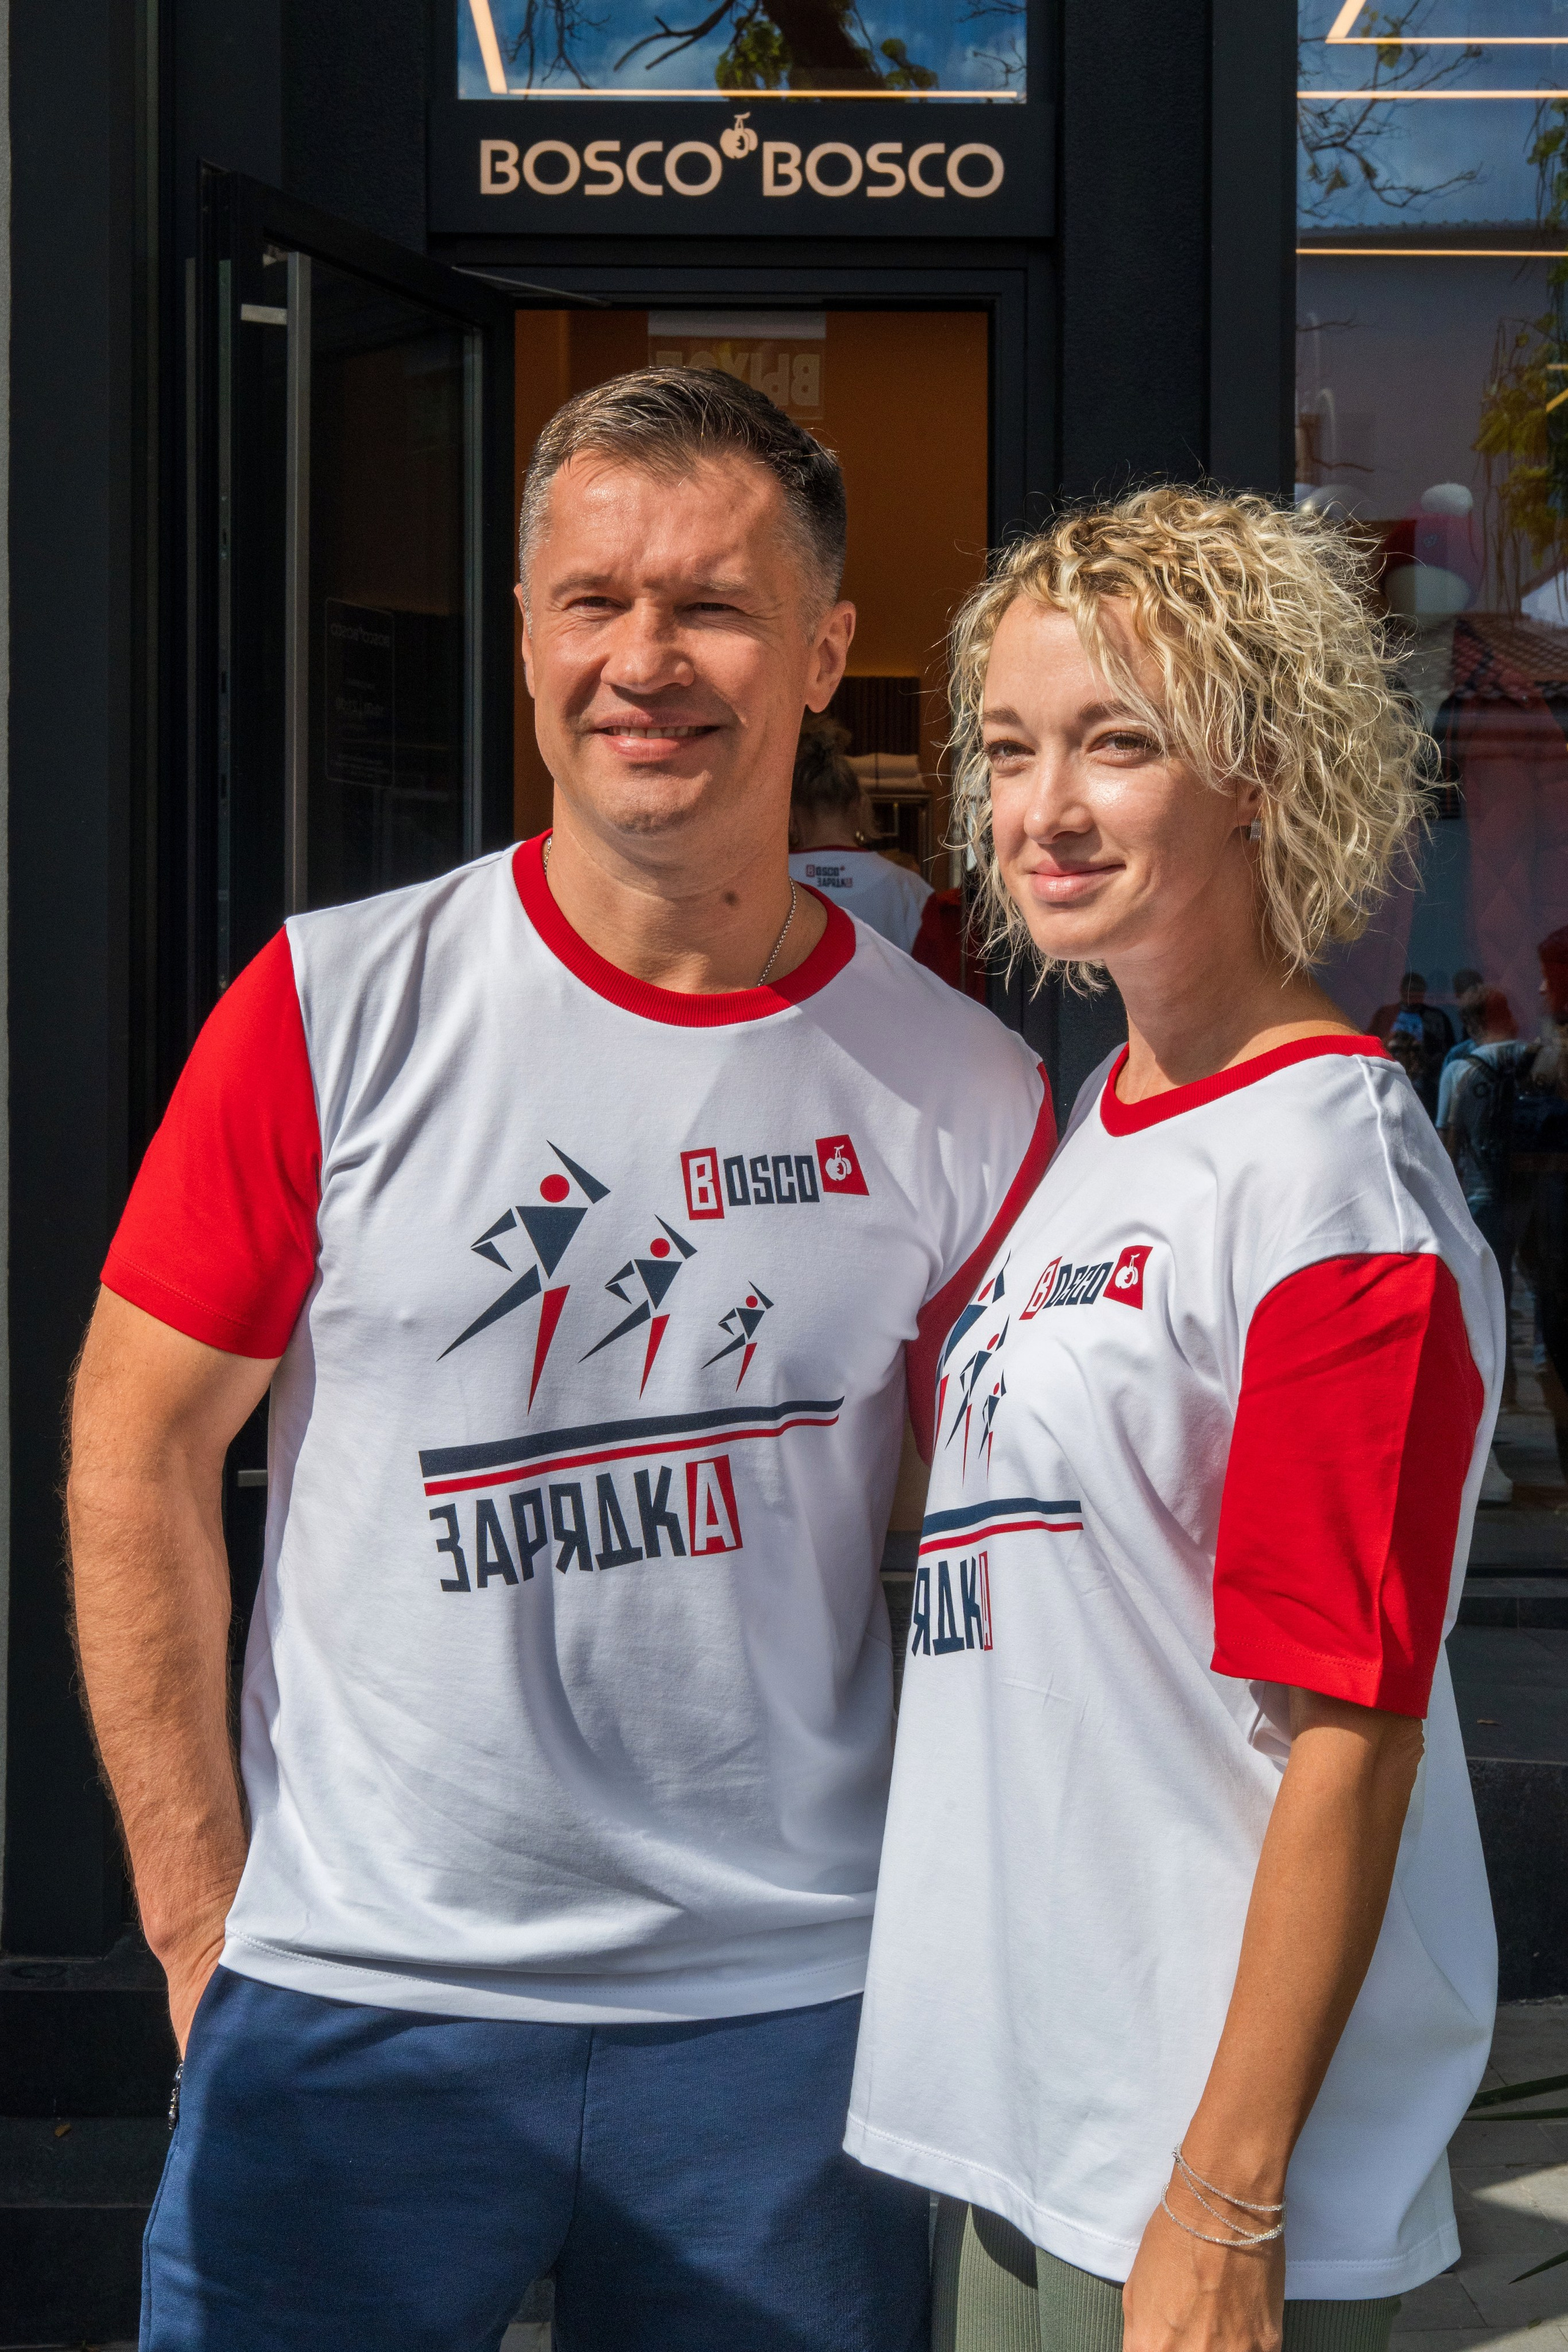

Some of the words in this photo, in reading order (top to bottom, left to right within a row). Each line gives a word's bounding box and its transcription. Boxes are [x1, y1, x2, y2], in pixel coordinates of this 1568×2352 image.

[480, 140, 723, 196] BOSCO
[763, 141, 1005, 198] BOSCO
[805, 864, 840, 877] BOSCO
[680, 1148, 820, 1219] BOSCO
[1019, 1256, 1114, 1320] BOSCO
[429, 1454, 743, 1593] ЗАРЯДКА
